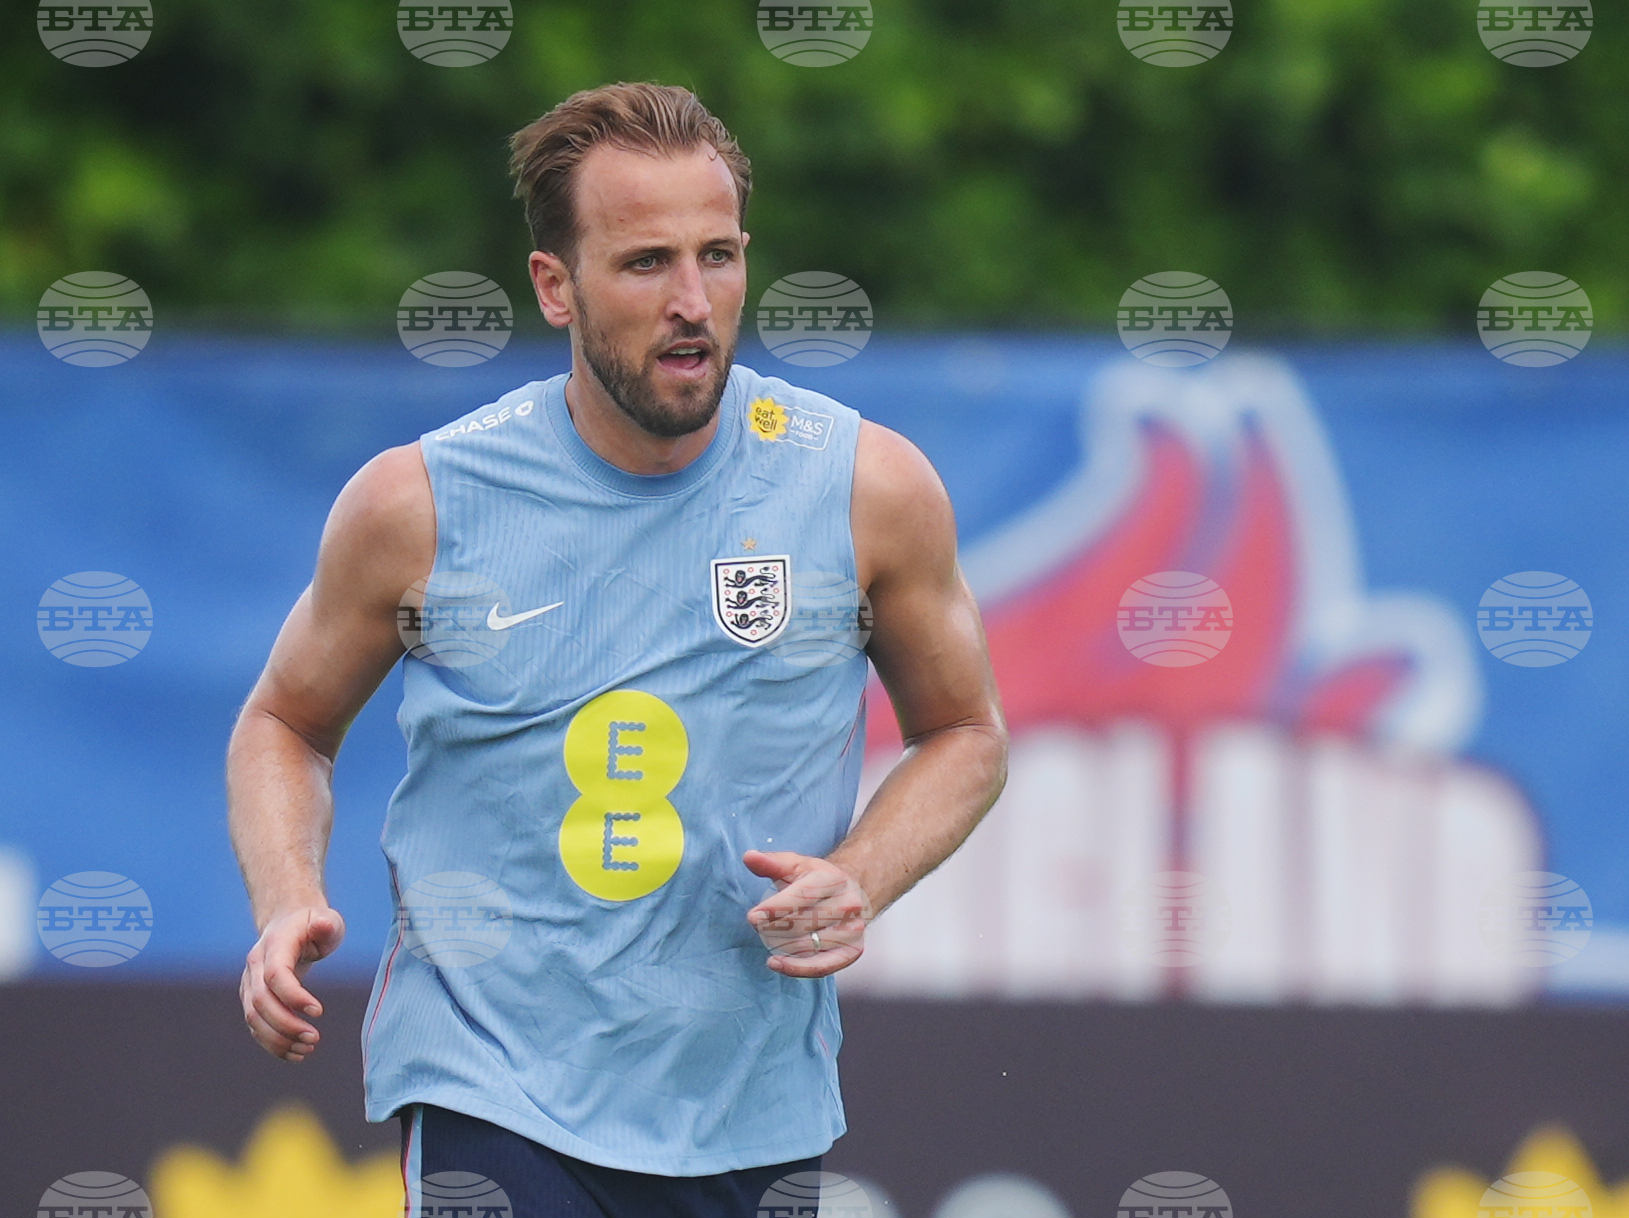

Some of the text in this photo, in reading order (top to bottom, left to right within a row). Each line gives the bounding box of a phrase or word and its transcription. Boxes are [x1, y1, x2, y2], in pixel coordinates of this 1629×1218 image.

[755, 407, 775, 420] eat
[435, 406, 512, 441] CHASE
[754, 415, 778, 431] well
[790, 415, 824, 435] M&S
